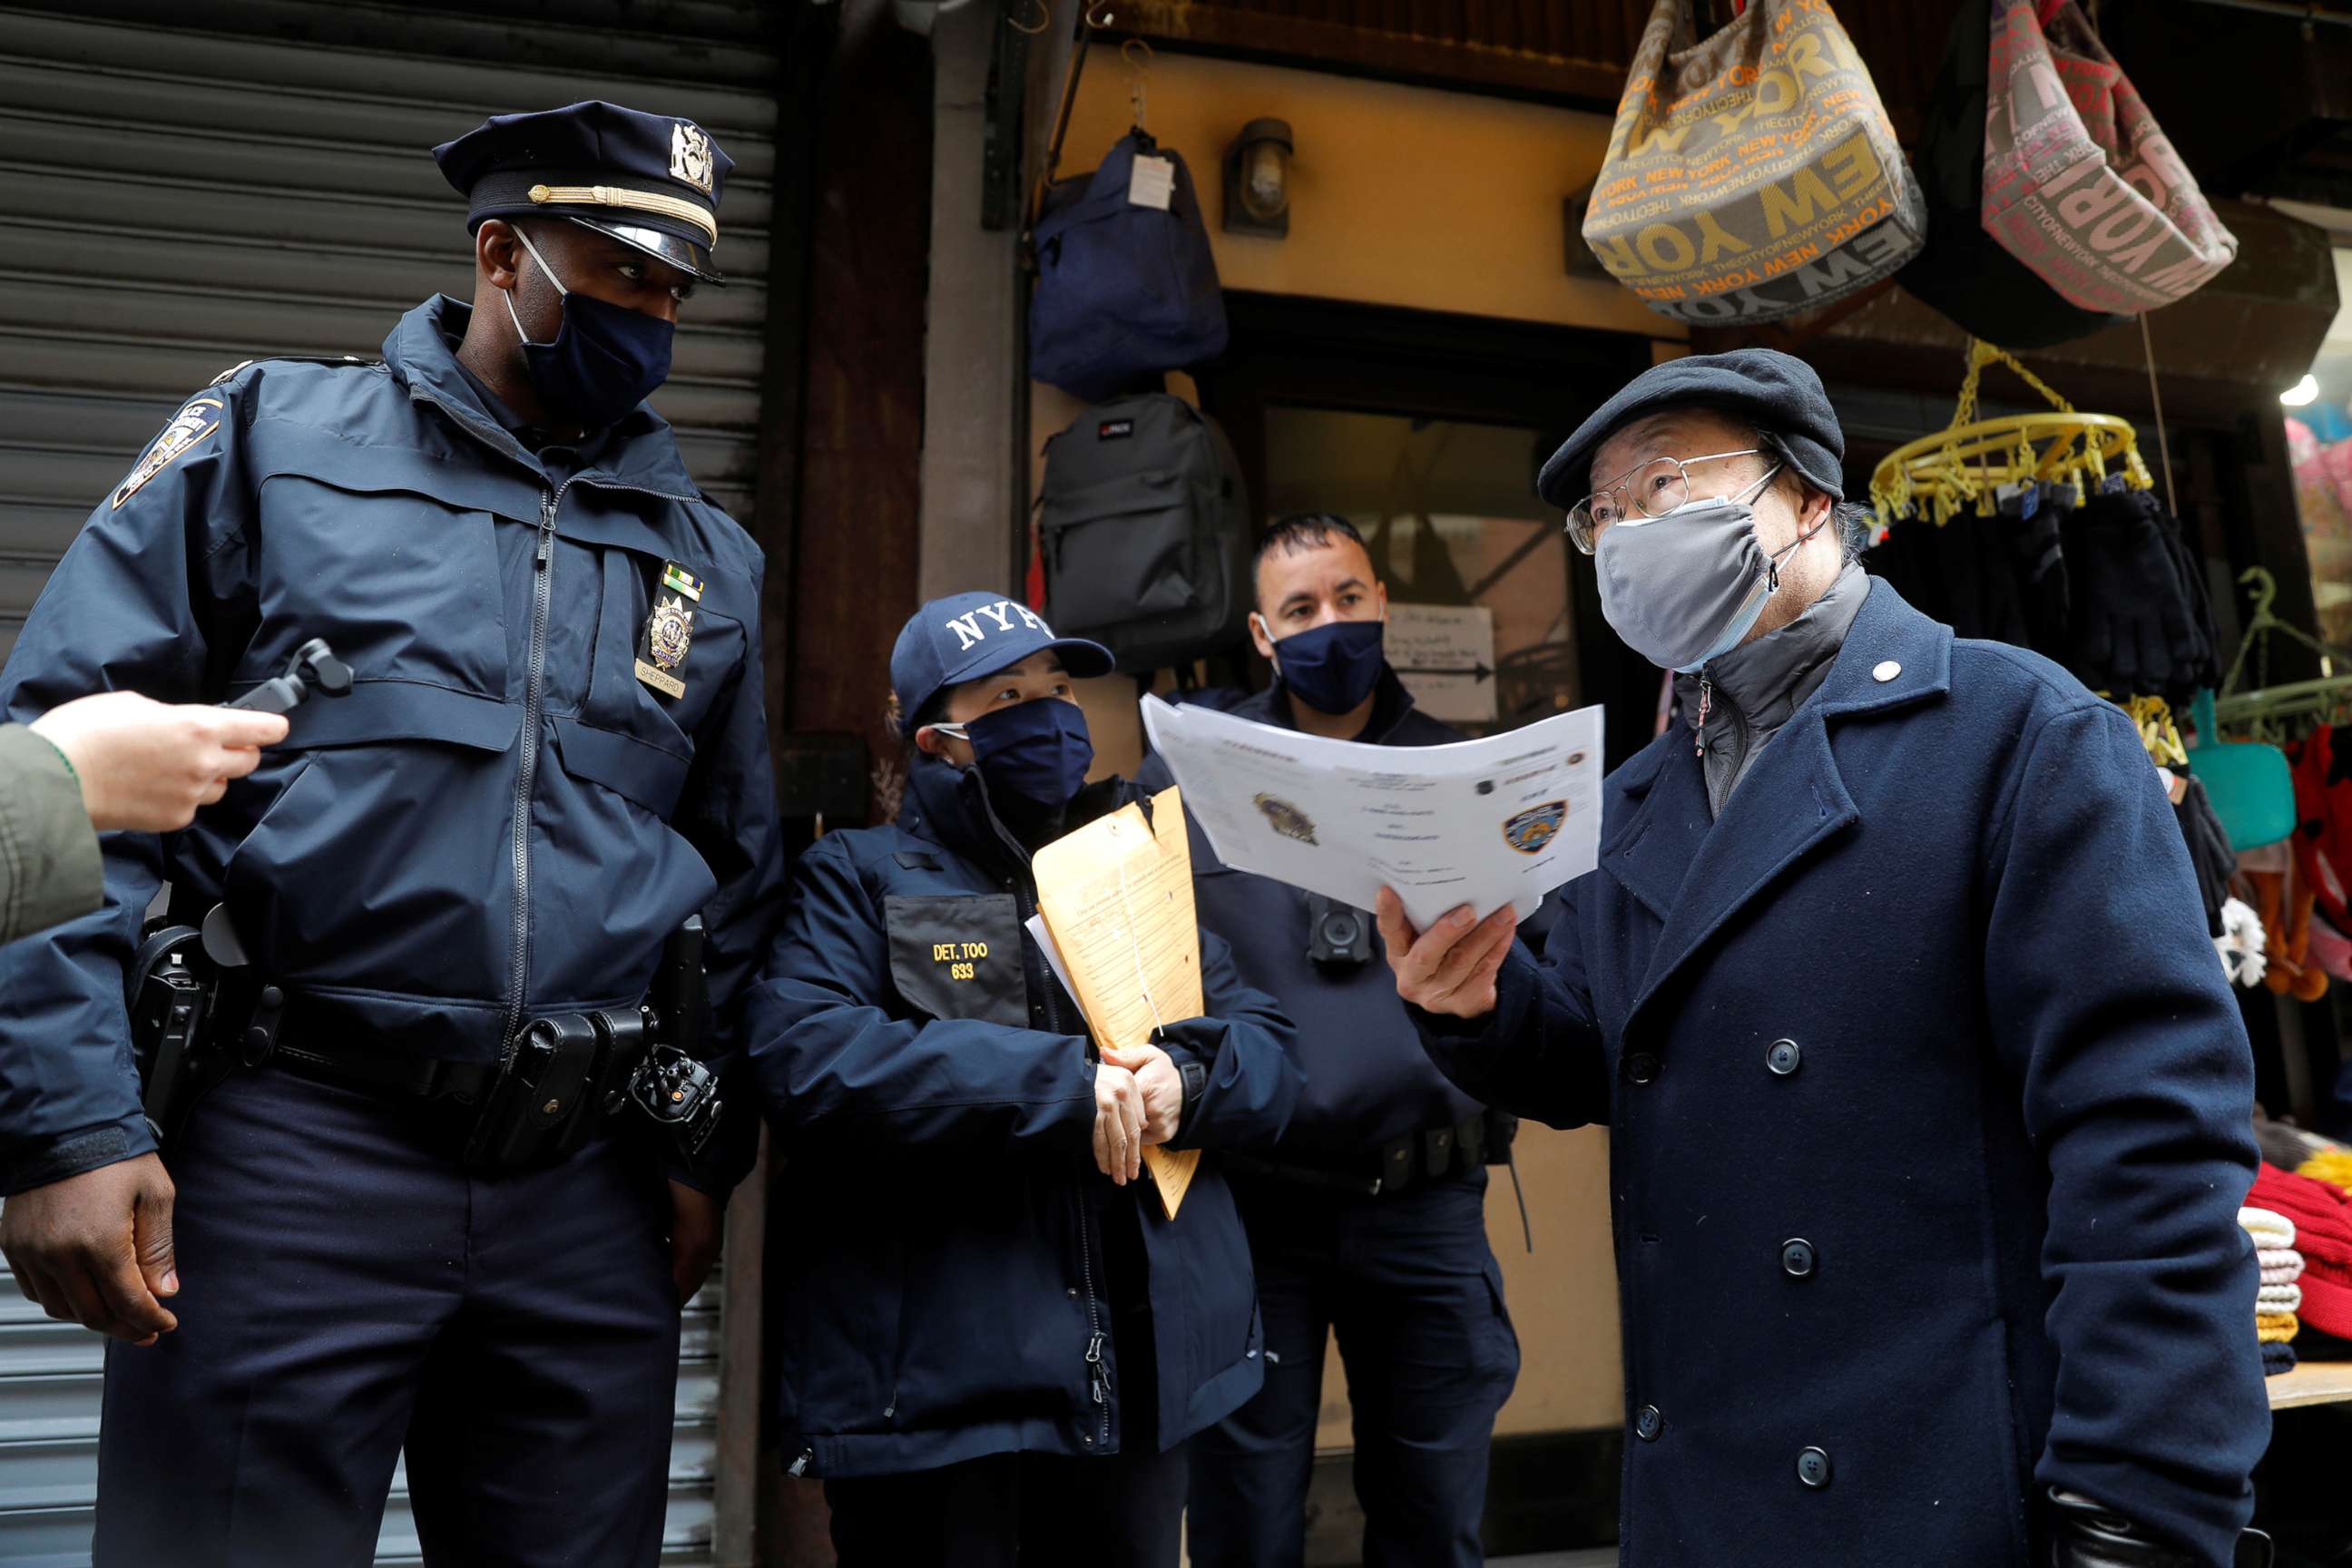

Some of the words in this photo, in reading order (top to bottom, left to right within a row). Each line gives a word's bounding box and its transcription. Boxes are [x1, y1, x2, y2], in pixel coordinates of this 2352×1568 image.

[1737, 132, 1776, 158] NEW
[1825, 196, 1893, 247] YORK
[1763, 240, 1819, 276] NEW
[1691, 268, 1761, 297] YORK
[641, 667, 680, 692] SHEPPARD
[933, 944, 960, 961] DET.
[961, 942, 987, 959] TOO
[951, 963, 974, 979] 633
